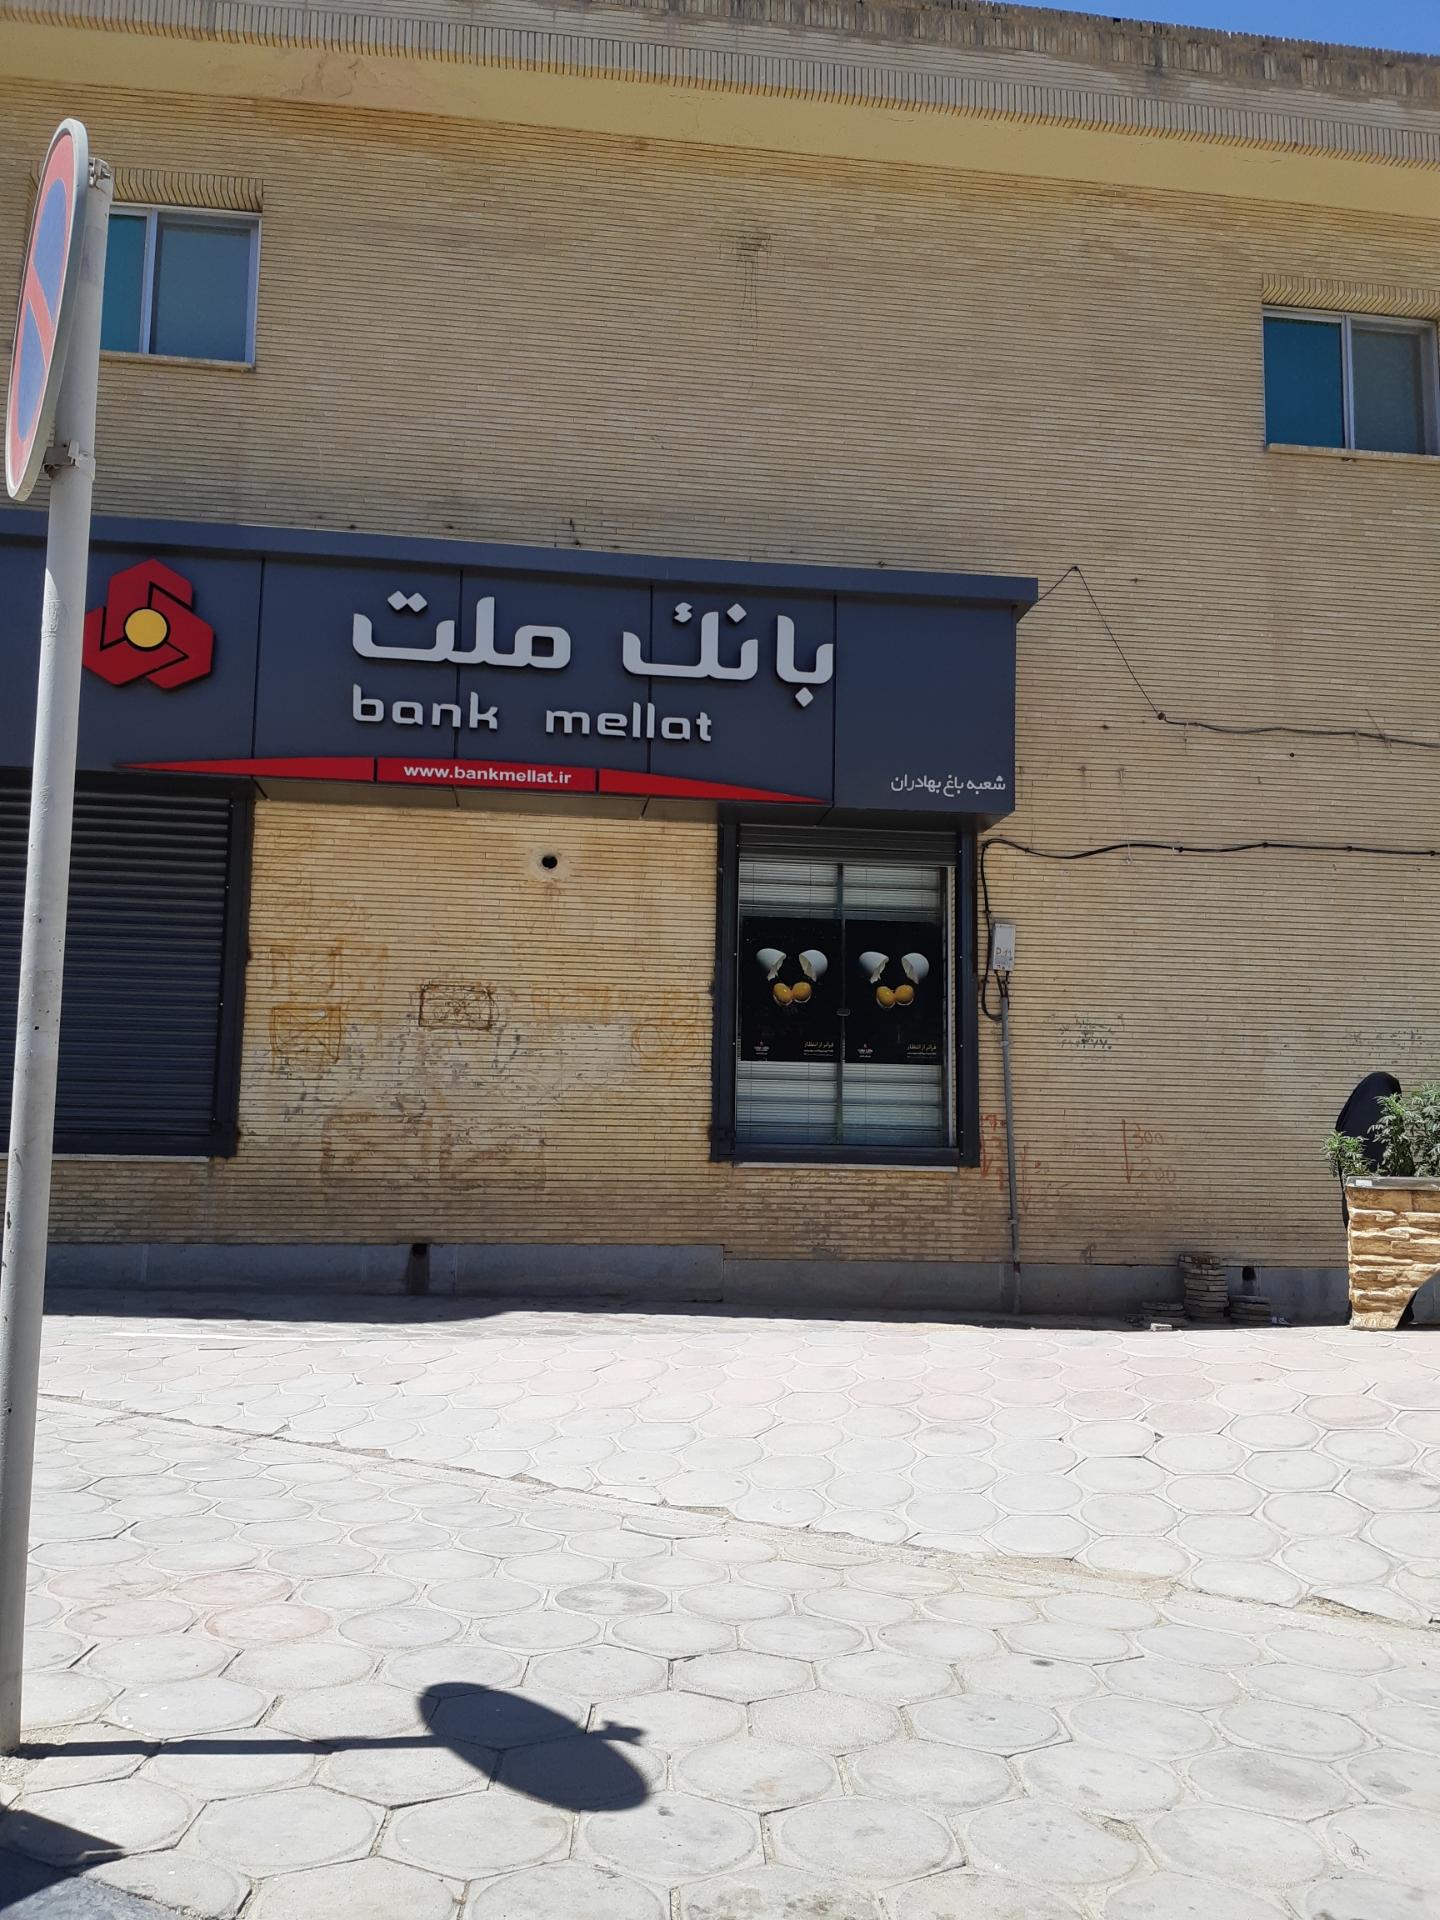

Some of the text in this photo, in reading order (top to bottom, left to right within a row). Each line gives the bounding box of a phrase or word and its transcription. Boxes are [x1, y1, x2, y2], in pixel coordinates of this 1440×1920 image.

[351, 589, 835, 708] بانک ملت
[352, 683, 713, 742] bank mellat
[403, 764, 573, 785] www.bankmellat.ir
[890, 773, 1006, 797] شعبه باغ بهادران
